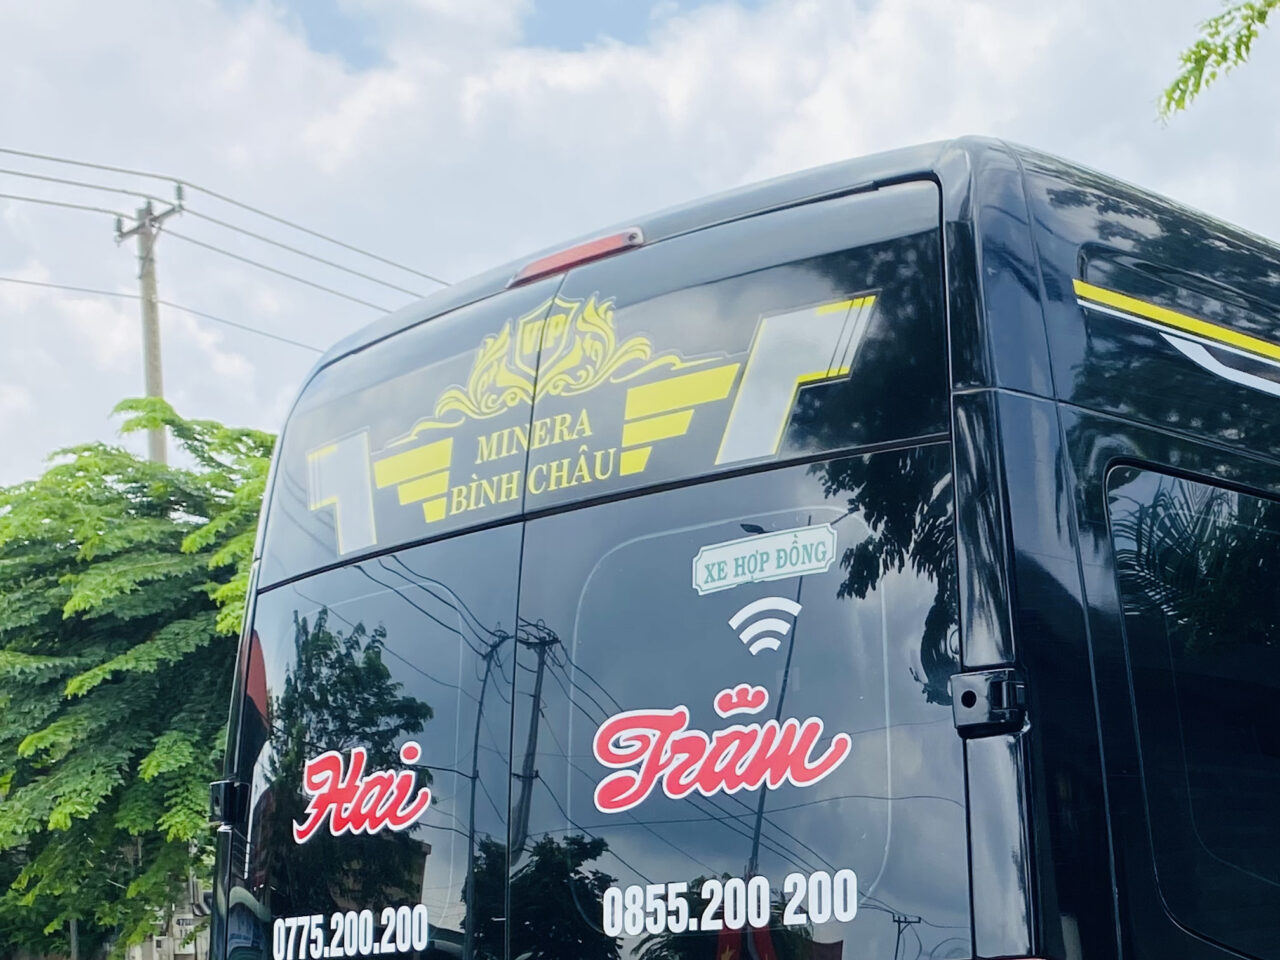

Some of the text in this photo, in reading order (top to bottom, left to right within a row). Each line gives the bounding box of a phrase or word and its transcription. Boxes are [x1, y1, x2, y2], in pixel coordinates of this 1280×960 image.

[475, 408, 594, 465] MINERA
[449, 444, 617, 516] BÌNH CHÂU
[704, 533, 827, 585] XE HỢP ĐỒNG
[293, 741, 431, 844] Hai
[782, 868, 858, 926] 200
